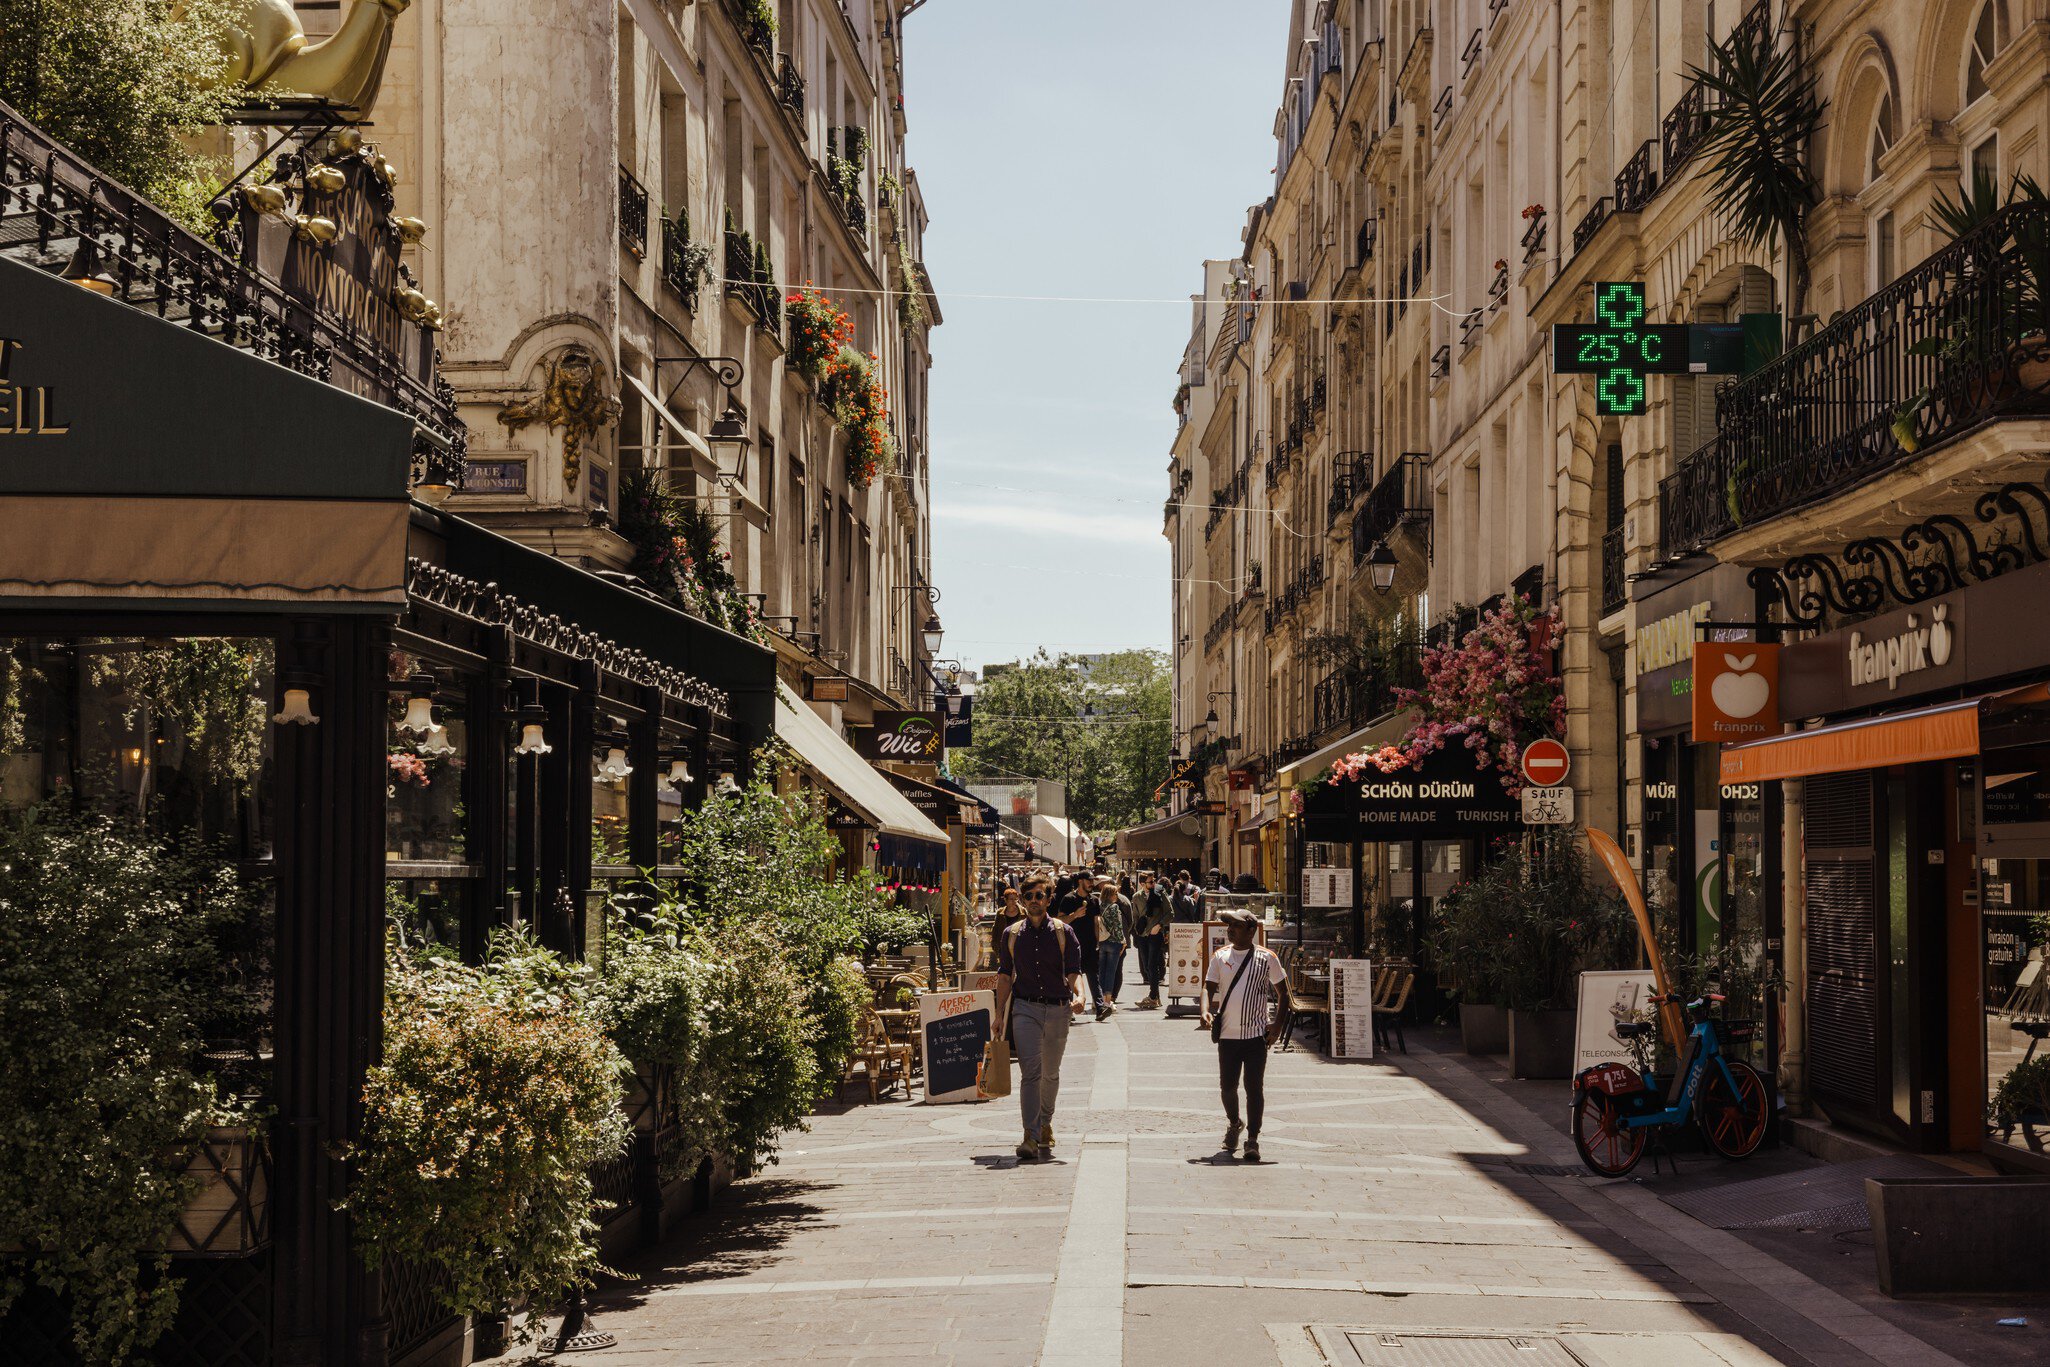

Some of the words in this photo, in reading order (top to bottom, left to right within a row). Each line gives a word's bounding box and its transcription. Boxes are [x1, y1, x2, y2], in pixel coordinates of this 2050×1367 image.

[296, 238, 404, 358] MONTORGUEIL
[1578, 332, 1661, 362] 25°C
[475, 467, 500, 477] RUE
[1849, 613, 1930, 690] franprix
[1713, 720, 1766, 734] franprix
[877, 733, 922, 754] Wic
[1174, 781, 1196, 789] PIZZA
[1361, 781, 1413, 798] SCHÖN
[1419, 781, 1475, 798] DÜRÜM
[903, 790, 932, 798] Waffles
[1532, 790, 1564, 798] SAUF
[1359, 811, 1397, 823] HOME
[1400, 811, 1437, 822] MADE
[1456, 810, 1509, 822] TURKISH
[1988, 928, 2014, 944] livraison
[1988, 946, 2013, 965] gratuite
[939, 994, 976, 1011] APEROL
[945, 1004, 970, 1017] SPRITZ
[1687, 1064, 1706, 1098] dott
